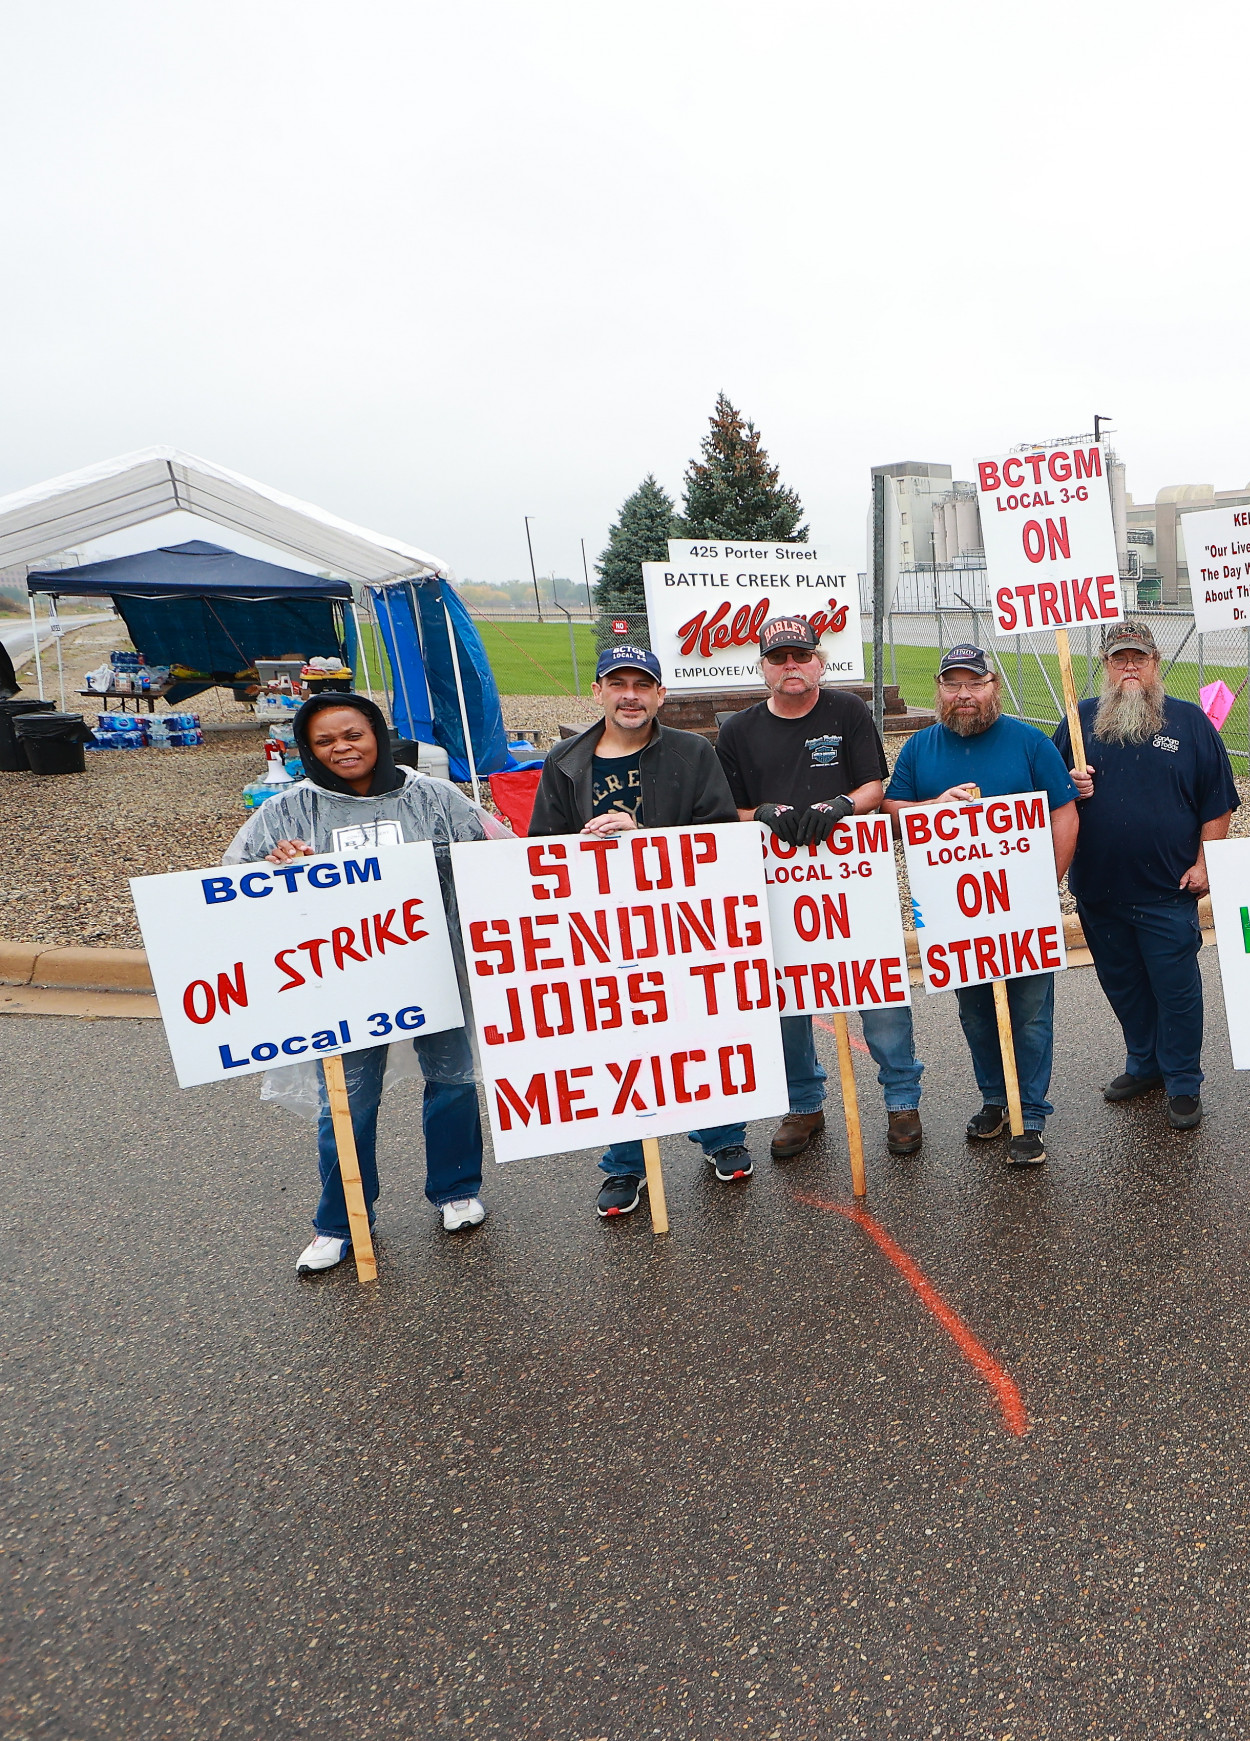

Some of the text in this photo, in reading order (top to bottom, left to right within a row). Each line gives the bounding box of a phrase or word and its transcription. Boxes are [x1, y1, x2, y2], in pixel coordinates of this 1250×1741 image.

[978, 447, 1102, 491] BCTGM
[996, 485, 1088, 511] LOCAL 3-G
[689, 546, 817, 560] 425 Porter Street
[1022, 516, 1071, 563] ON
[1204, 544, 1228, 558] "Our
[664, 572, 847, 588] BATTLE CREEK PLANT
[1200, 569, 1219, 581] The
[1222, 565, 1241, 580] Day
[1204, 588, 1233, 604] About
[996, 575, 1118, 630] STRIKE
[1233, 607, 1247, 620] Dr.
[677, 597, 849, 657] Kellg's
[612, 646, 646, 657] BCTGM
[613, 652, 633, 660] LOCAL
[675, 665, 759, 678] EMPLOYEE/VI
[904, 798, 1046, 846] BCTGM
[526, 832, 718, 901] STOP
[765, 861, 873, 885] LOCAL 3-G
[926, 837, 1031, 866] LOCAL 3-G
[201, 857, 382, 905] BCTGM
[956, 868, 1010, 918] ON
[469, 894, 763, 977] SENDING
[793, 893, 851, 942] ON
[183, 898, 430, 1025] ON STRIKE
[926, 925, 1061, 988] STRIKE
[483, 958, 772, 1046] JOBS TO
[218, 1006, 427, 1070] Local 3G
[494, 1043, 757, 1132] MEXICO
